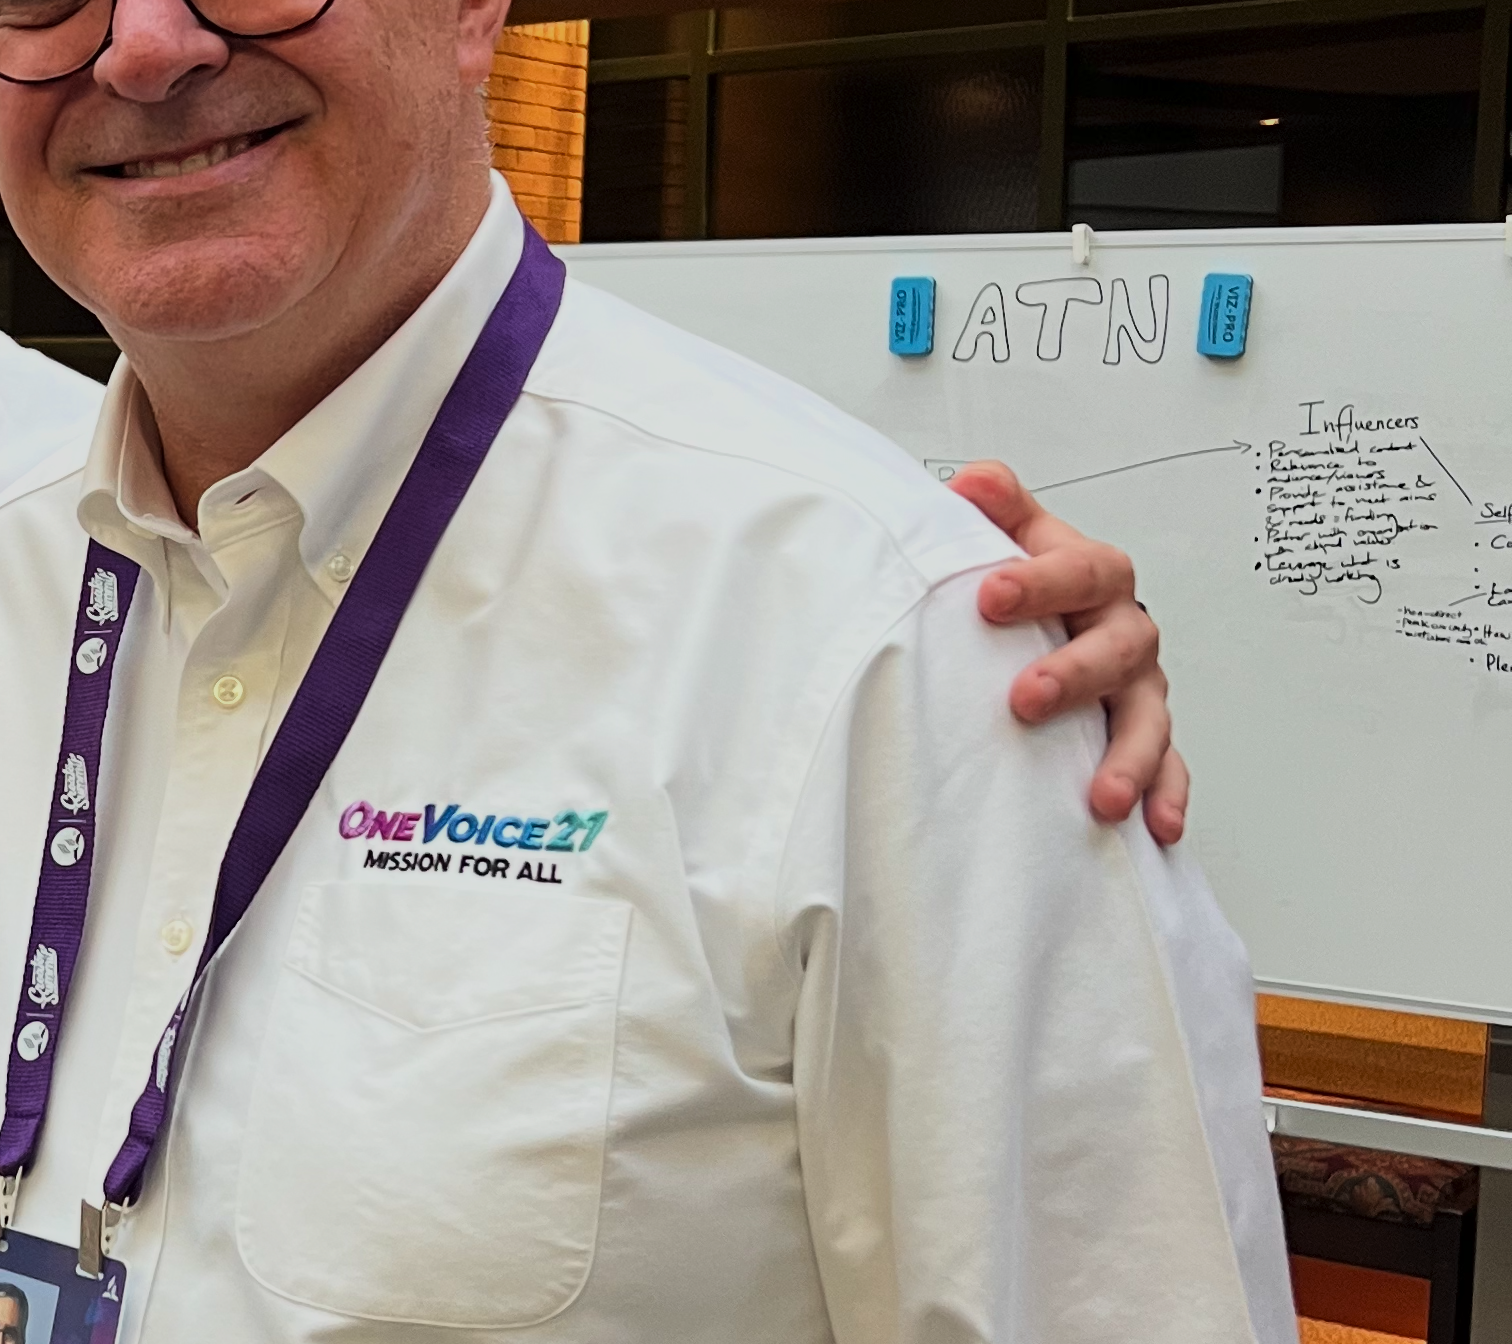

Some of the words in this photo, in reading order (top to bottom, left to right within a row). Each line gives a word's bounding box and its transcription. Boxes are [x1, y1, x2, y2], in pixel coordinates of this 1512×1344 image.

[952, 274, 1169, 365] ATN
[1222, 286, 1240, 343] VIZ-PRO
[1298, 400, 1419, 444] Influencers
[364, 850, 452, 873] MISSION
[459, 855, 510, 879] FOR
[516, 862, 562, 884] ALL
